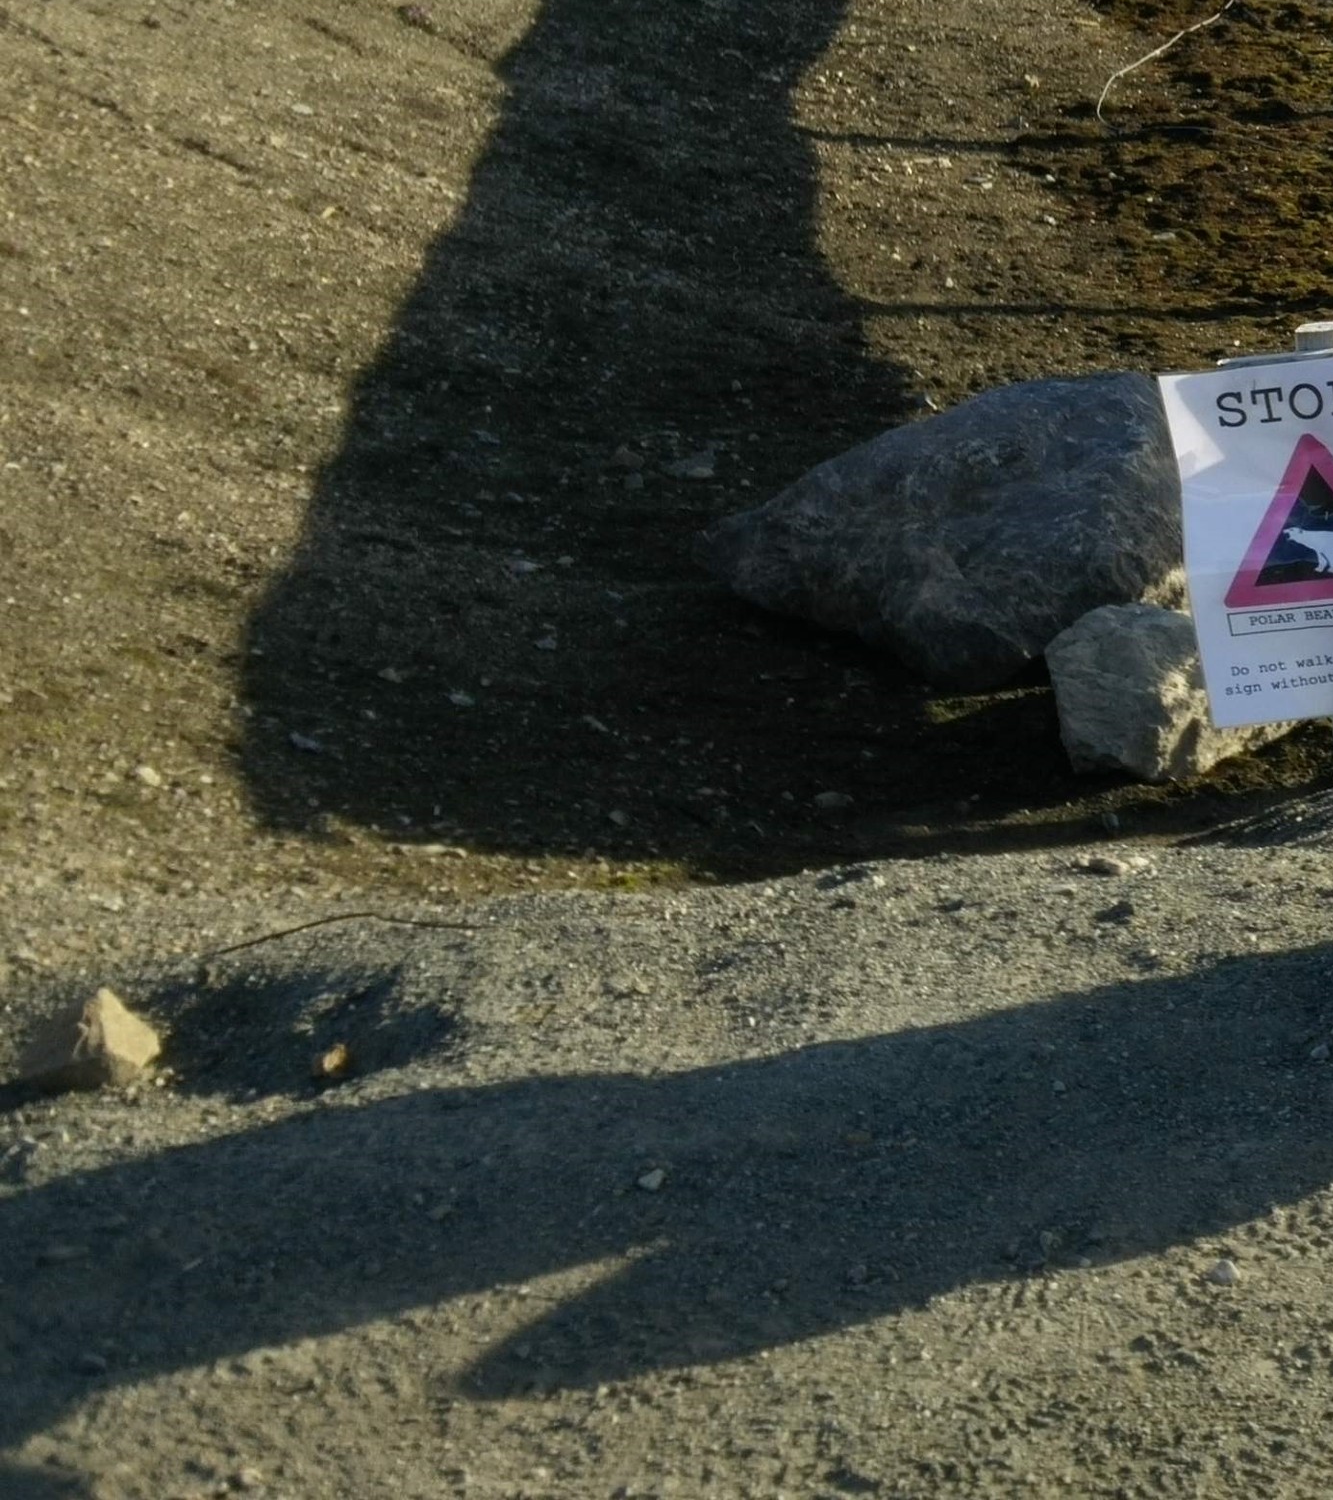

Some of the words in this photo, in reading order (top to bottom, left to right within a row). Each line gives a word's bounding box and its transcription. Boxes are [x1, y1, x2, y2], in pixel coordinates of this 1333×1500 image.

[1249, 613, 1296, 627] POLAR
[1230, 666, 1250, 678] Do
[1259, 660, 1288, 674] not
[1225, 682, 1263, 697] sign
